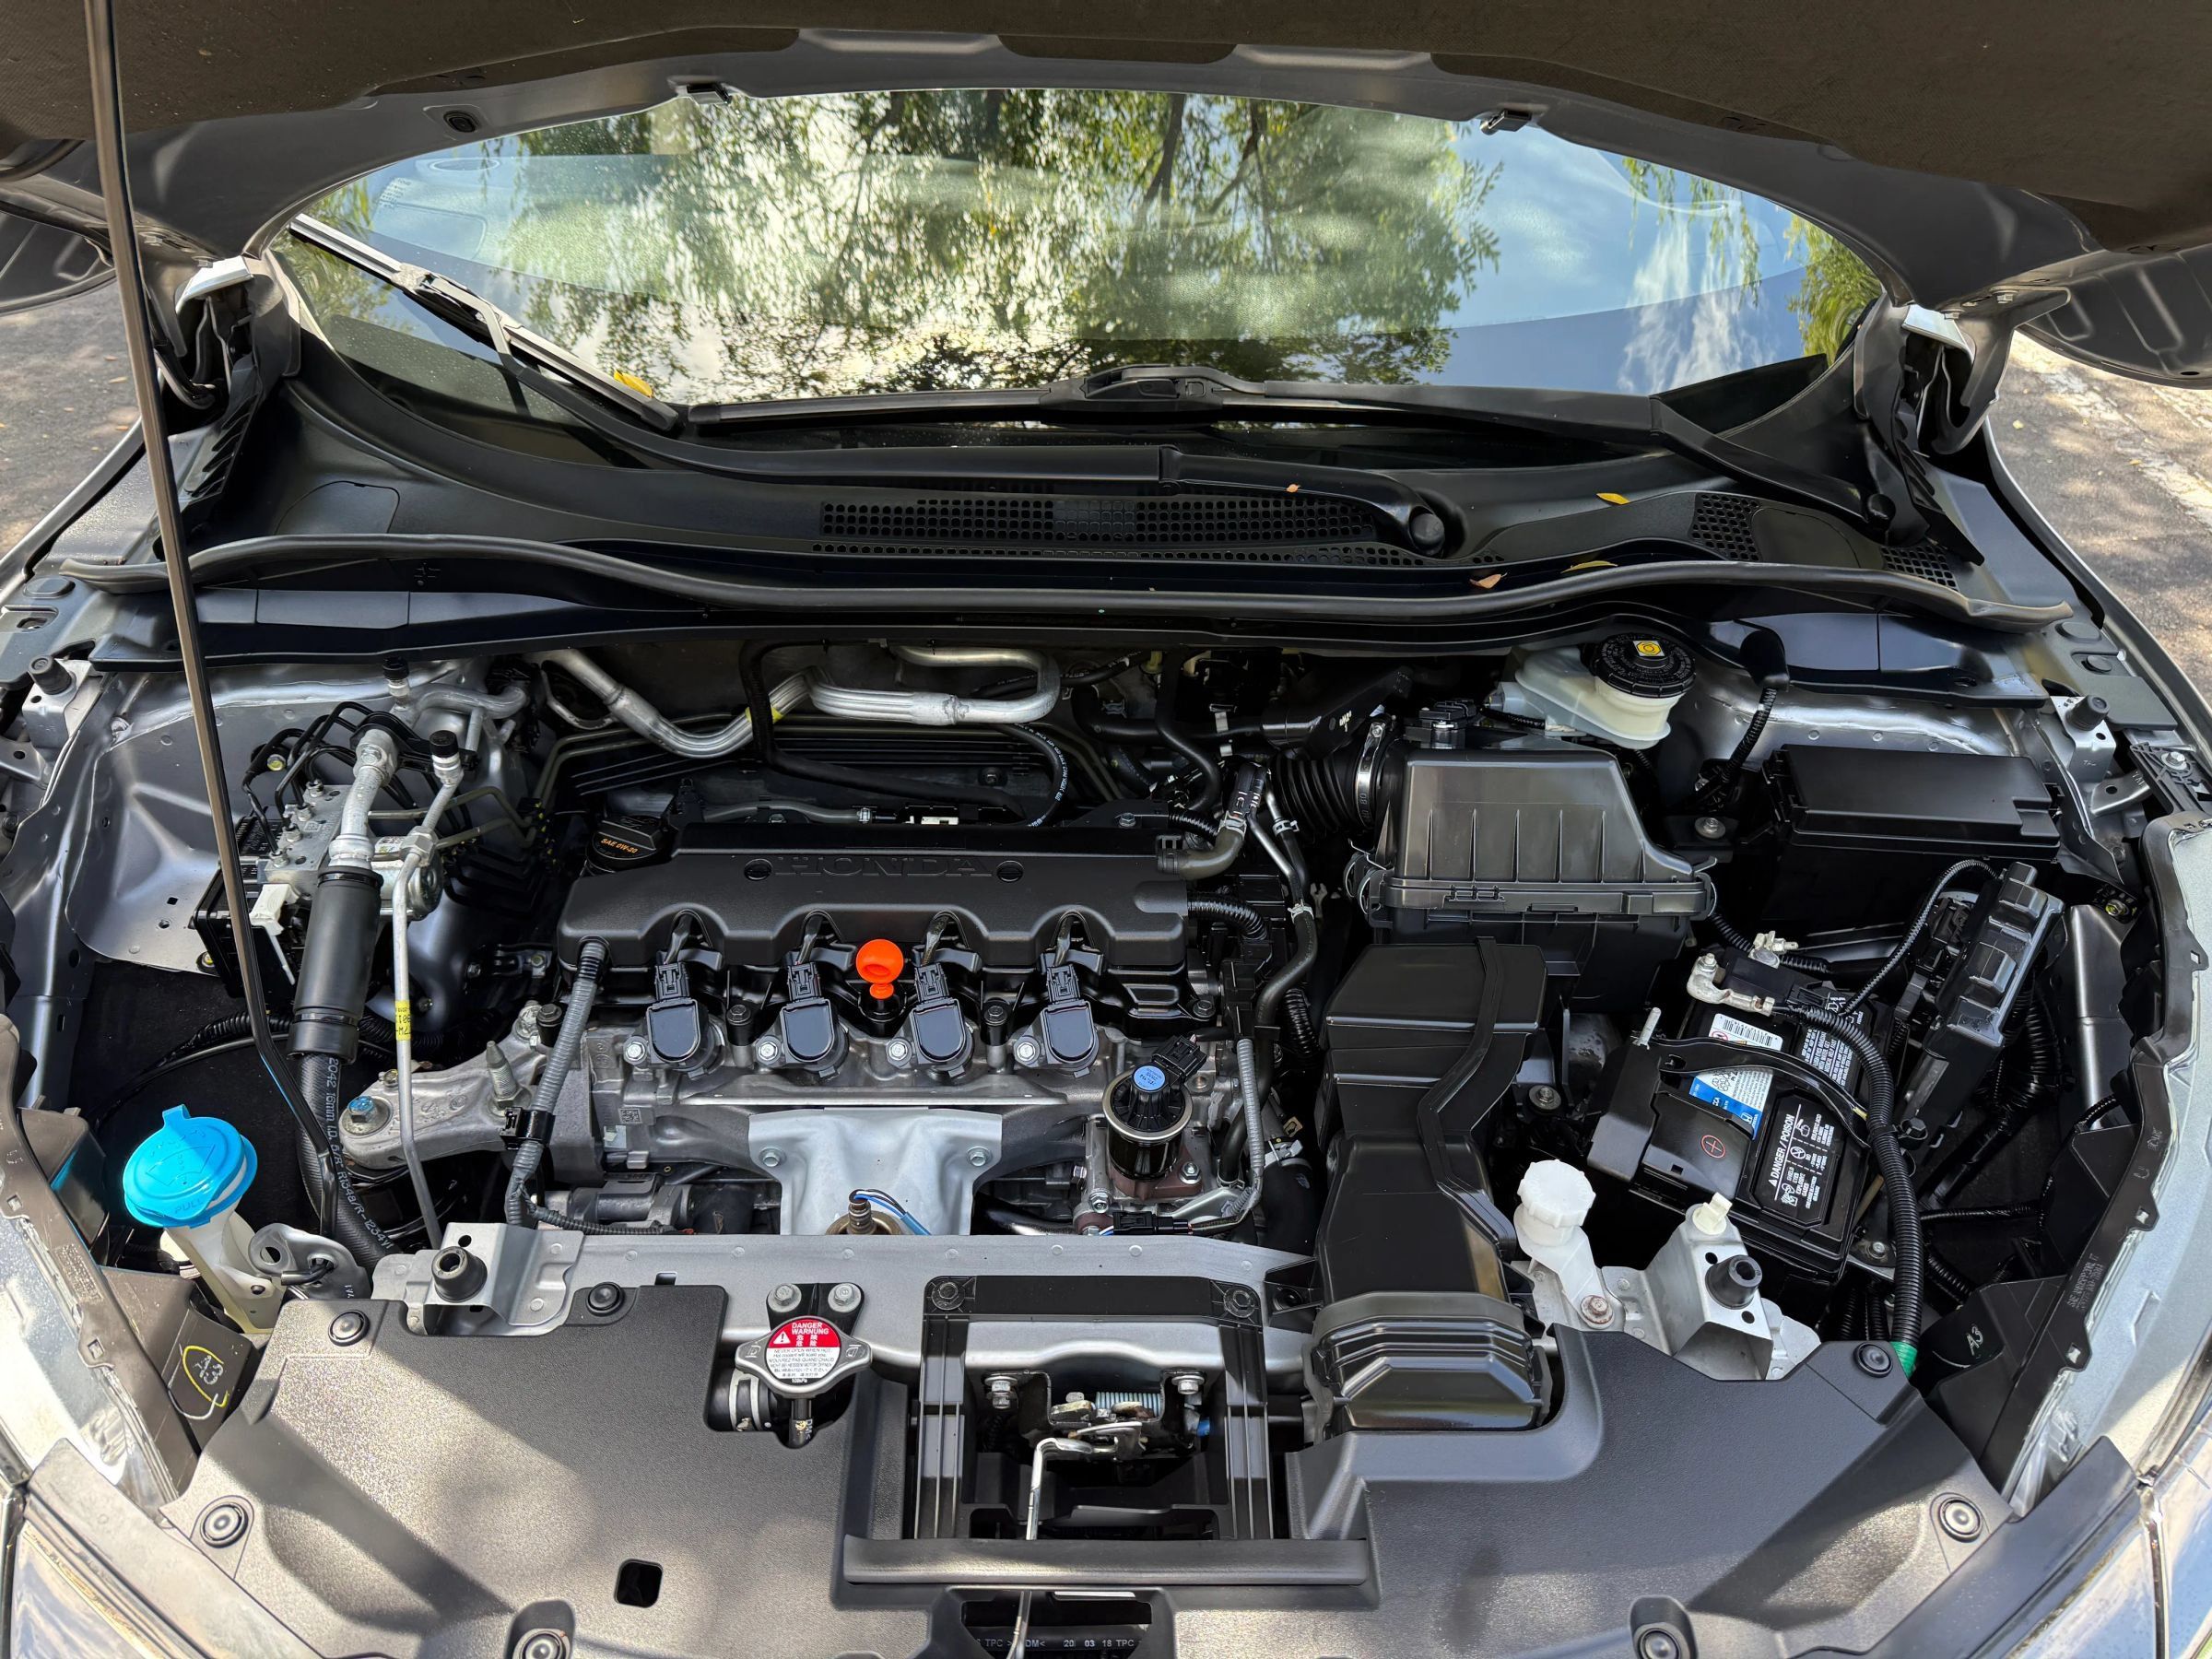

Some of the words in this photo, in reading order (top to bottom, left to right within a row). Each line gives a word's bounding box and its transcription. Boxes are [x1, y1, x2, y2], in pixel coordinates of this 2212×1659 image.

[600, 838, 617, 847] SAE
[616, 843, 638, 853] 0W-20
[774, 857, 993, 877] HONDA
[327, 1058, 339, 1088] 2042
[325, 1092, 336, 1123] 16mm
[1770, 1147, 1786, 1179] DANGER
[1781, 1114, 1795, 1142] POISON
[175, 1199, 204, 1214] PULL
[1966, 1326, 1983, 1355] A3
